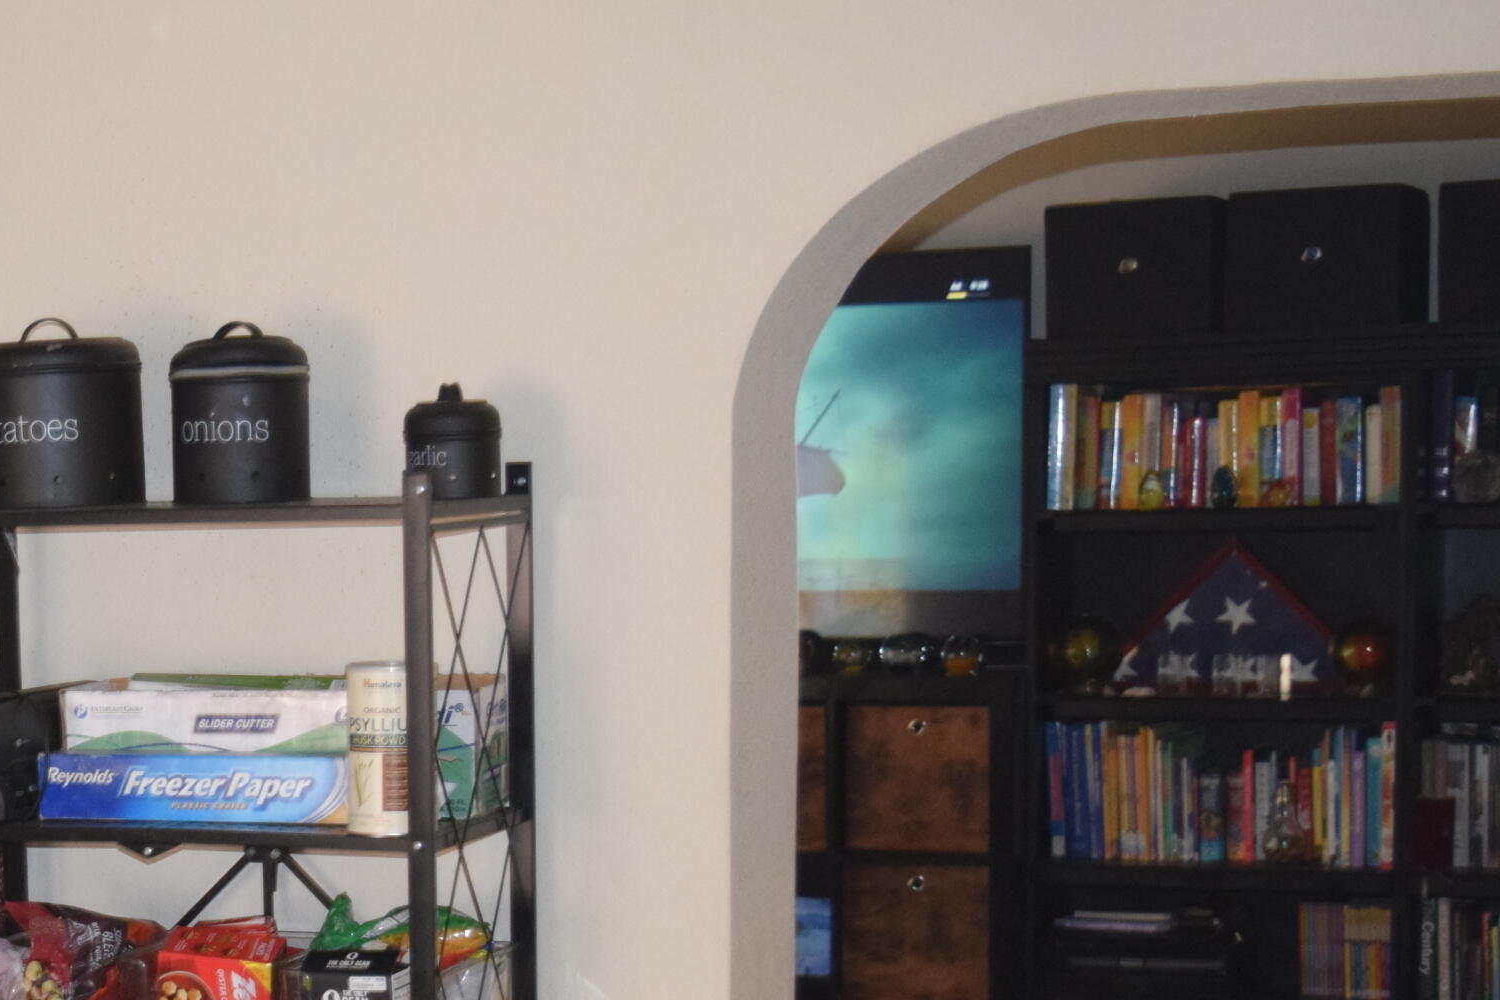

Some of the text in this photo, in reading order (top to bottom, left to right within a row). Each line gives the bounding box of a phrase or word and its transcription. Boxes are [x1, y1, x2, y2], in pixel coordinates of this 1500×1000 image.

[181, 414, 269, 444] onions
[364, 706, 401, 714] ORGANIC
[198, 717, 275, 730] SLIDER CUTTER
[350, 717, 408, 732] PSYLLIU
[352, 735, 406, 745] HUSK POWD
[48, 767, 311, 806] Reynolds Freezer Paper
[1419, 921, 1434, 975] Century
[217, 968, 227, 996] OYSTER
